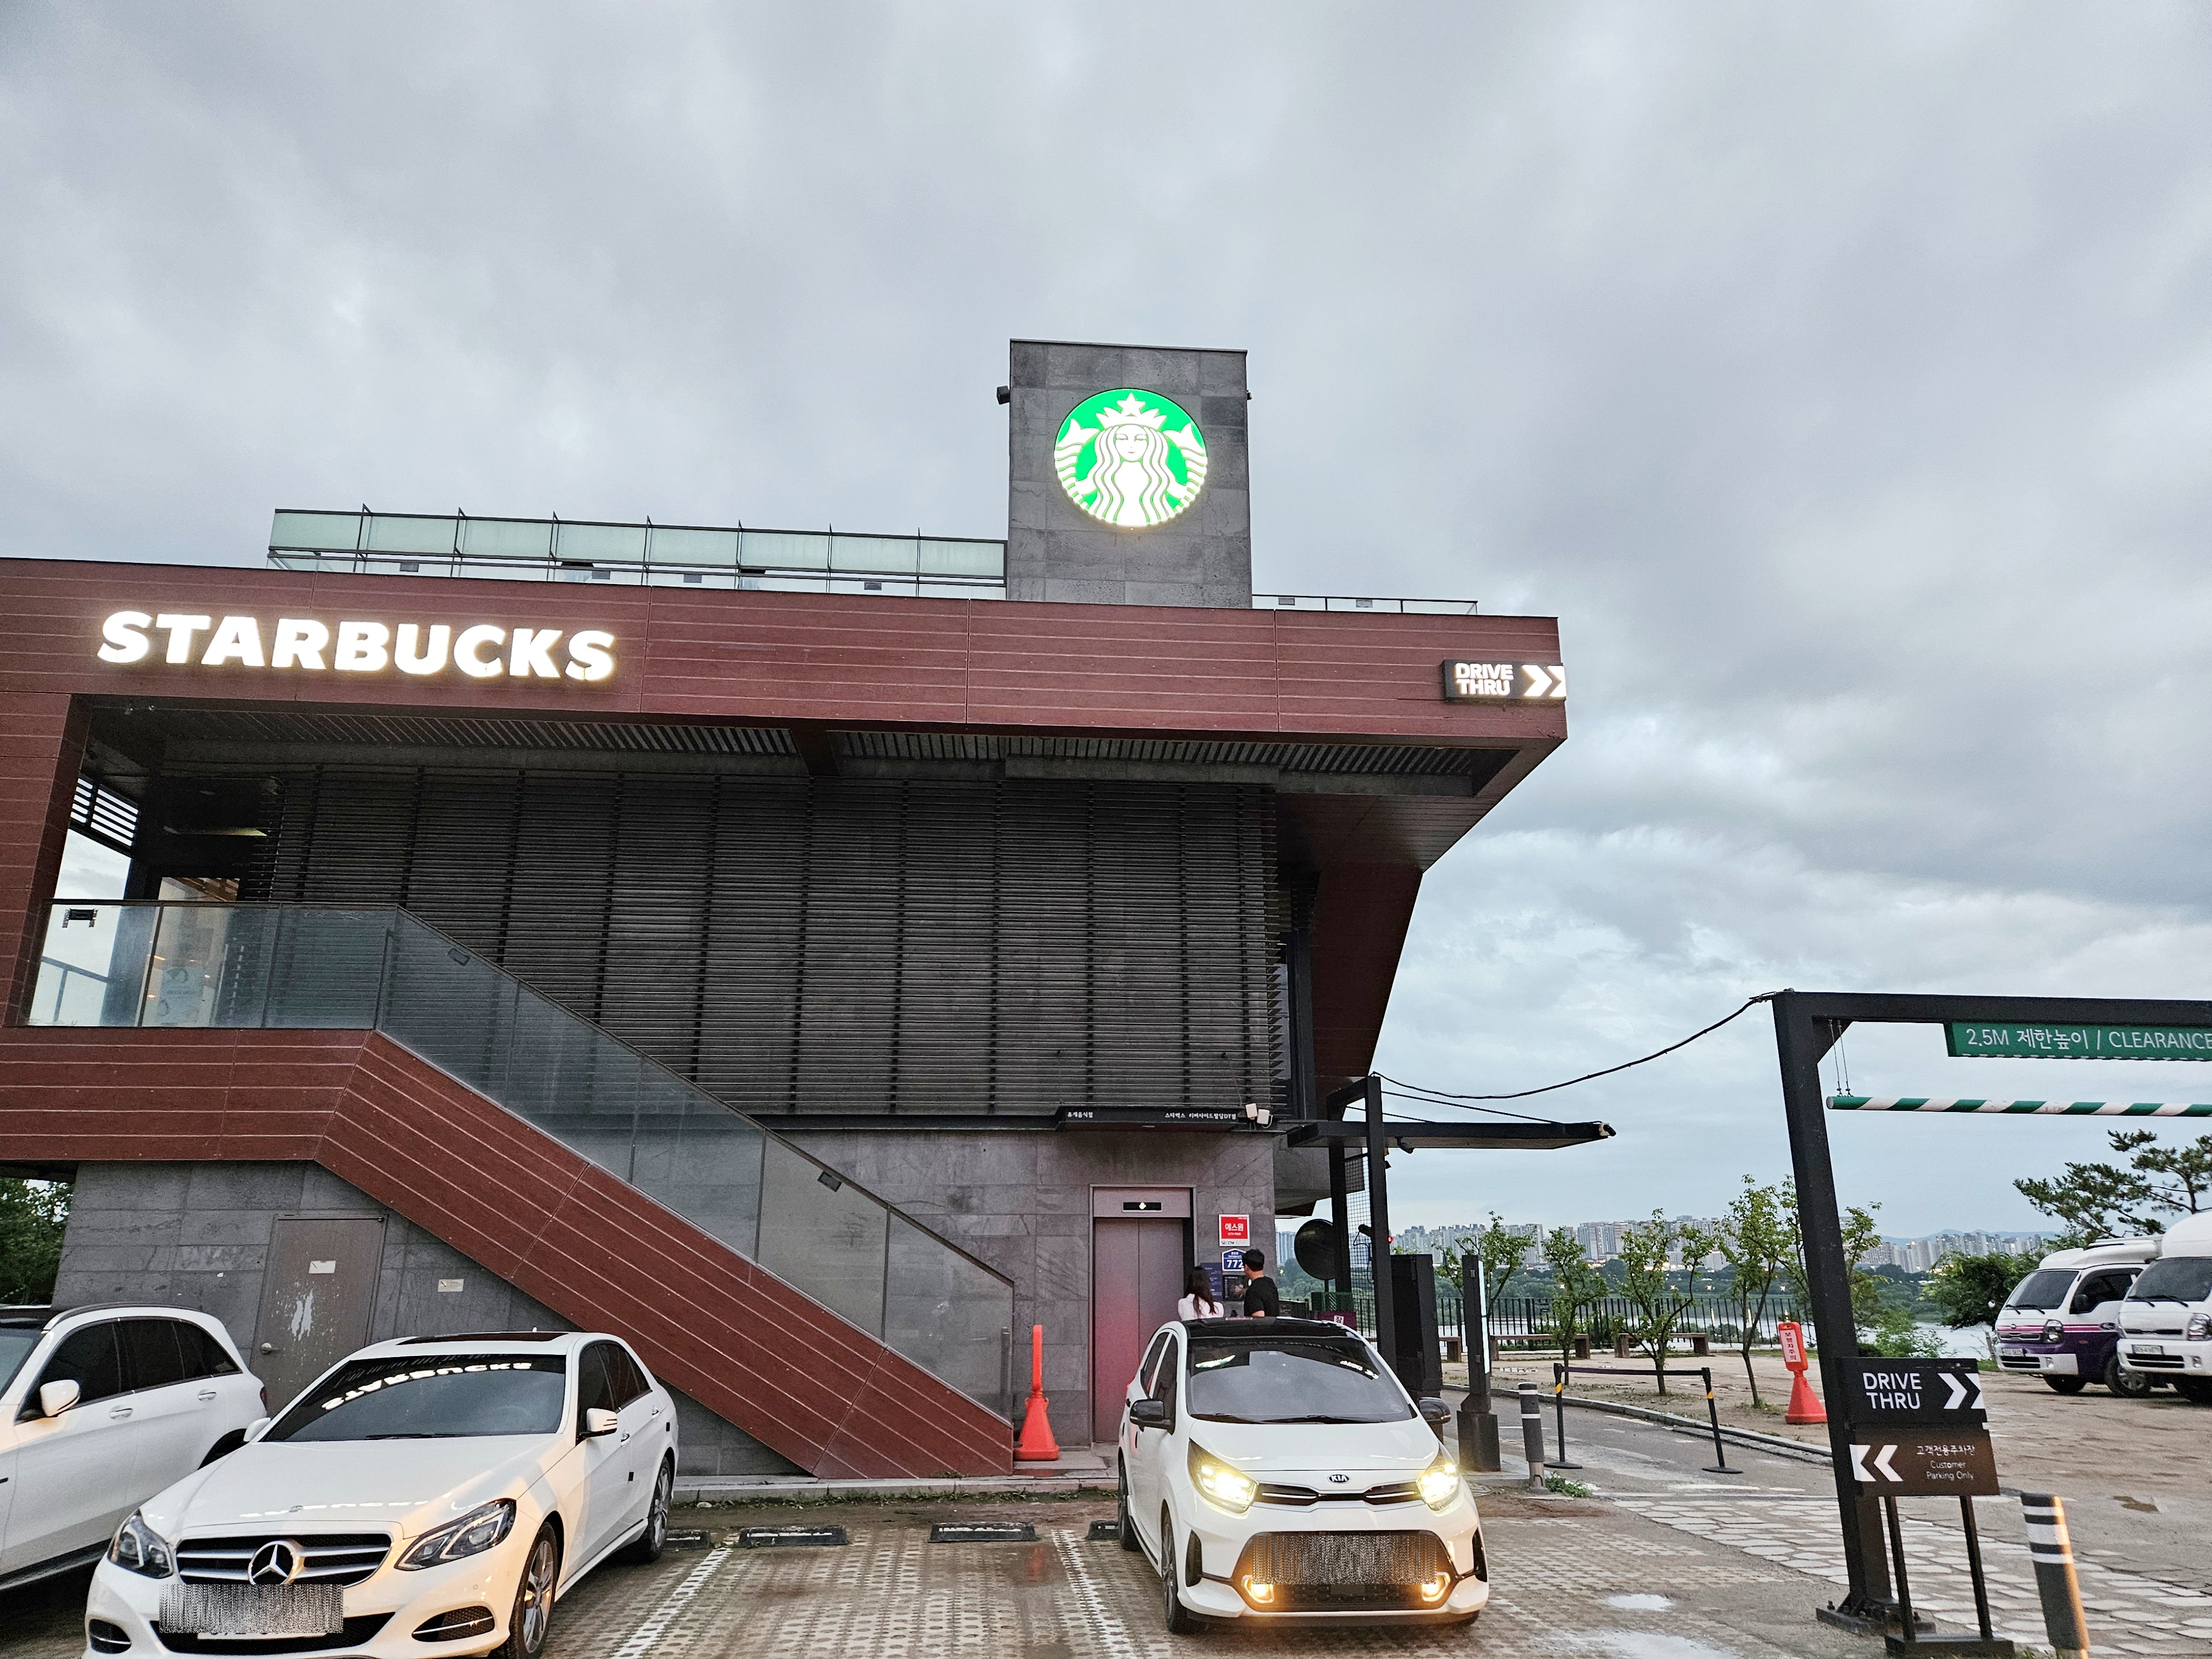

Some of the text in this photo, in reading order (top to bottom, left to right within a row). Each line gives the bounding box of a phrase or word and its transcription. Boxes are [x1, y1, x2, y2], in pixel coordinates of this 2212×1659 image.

[96, 611, 616, 681] STARBUCKS
[1455, 662, 1514, 680] DRIVE
[1455, 679, 1511, 695] THRU
[1966, 1028, 2010, 1046] 2.5M
[2016, 1028, 2089, 1050] 제한높이
[2108, 1031, 2212, 1049] CLEARANCE
[1227, 1259, 1244, 1268] 772
[1785, 1332, 1797, 1360] 보행자주의
[1862, 1373, 1923, 1390] DRIVE
[1865, 1392, 1921, 1410] THRU
[1917, 1444, 1975, 1456] 고객전용주차장
[1930, 1460, 1966, 1469] Customer
[1926, 1471, 1974, 1481] Parking Only
